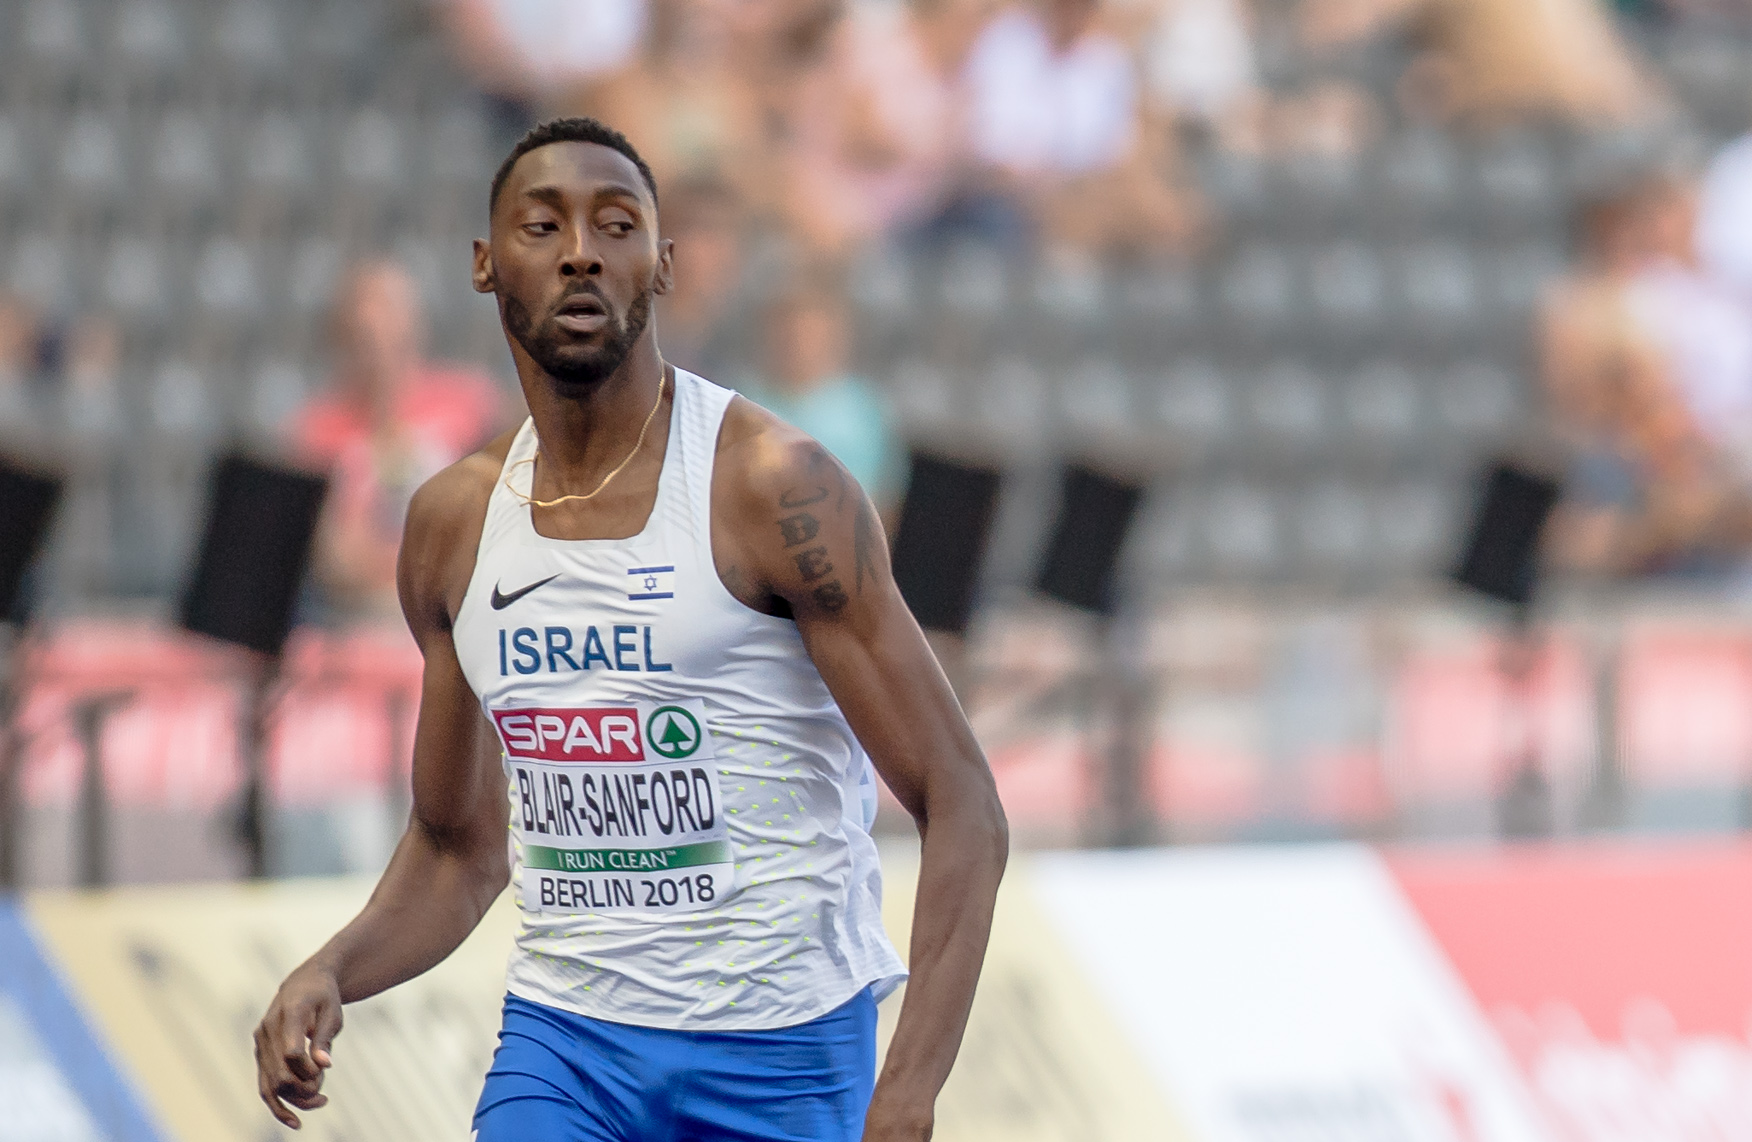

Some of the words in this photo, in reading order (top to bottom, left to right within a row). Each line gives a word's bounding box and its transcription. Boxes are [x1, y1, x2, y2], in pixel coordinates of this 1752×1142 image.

[499, 625, 673, 676] ISRAEL
[499, 714, 641, 755] SPAR
[516, 766, 715, 837] BLAIR-SANFORD
[557, 851, 564, 868] I
[565, 852, 605, 869] RUN
[540, 876, 635, 908] BERLIN
[640, 873, 715, 907] 2018
